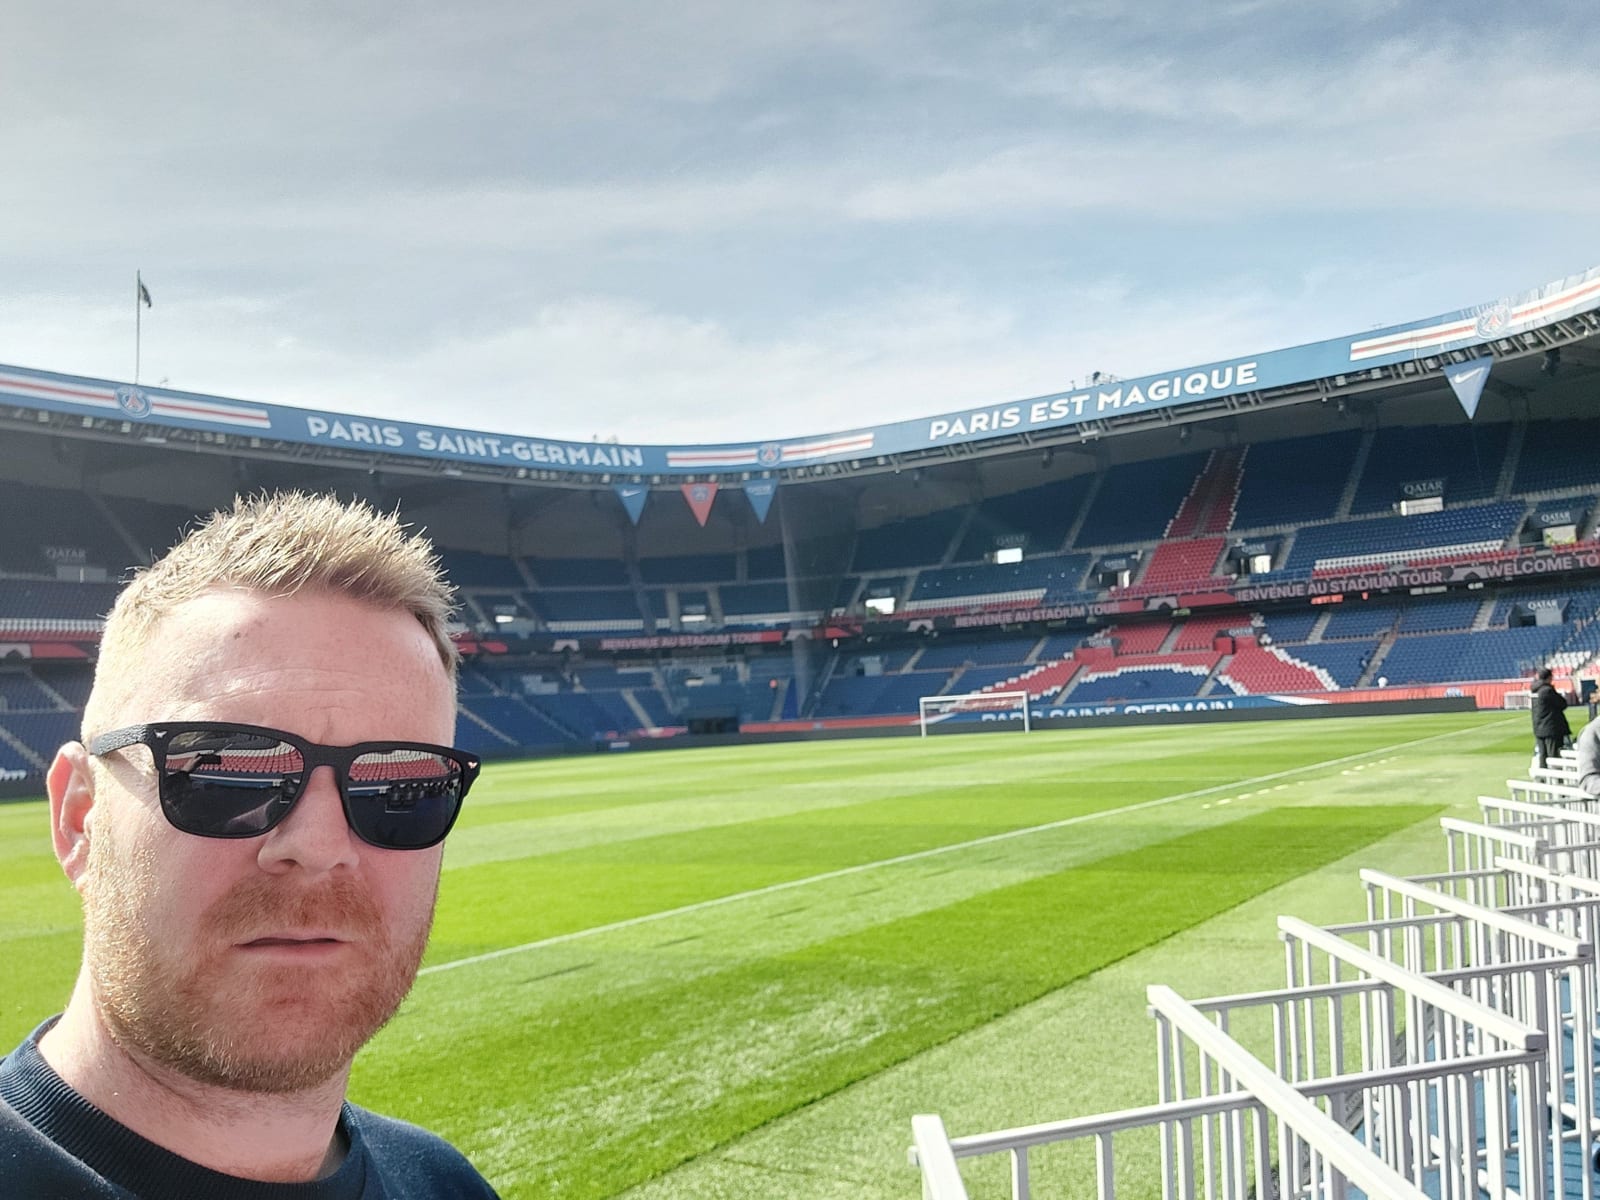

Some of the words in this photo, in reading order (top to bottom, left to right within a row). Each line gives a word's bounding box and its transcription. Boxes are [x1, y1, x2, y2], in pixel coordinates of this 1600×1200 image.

[929, 407, 1020, 440] PARIS
[1030, 395, 1090, 423] EST
[1097, 362, 1258, 411] MAGIQUE
[306, 416, 403, 447] PARIS
[416, 430, 643, 467] SAINT-GERMAIN
[1404, 481, 1443, 495] QATAR
[1541, 511, 1571, 523] QATAR
[1488, 556, 1573, 577] WELCOME
[1308, 581, 1328, 595] AU
[1330, 575, 1398, 593] STADIUM
[1401, 570, 1443, 586] TOUR
[1032, 605, 1085, 621] STADIUM
